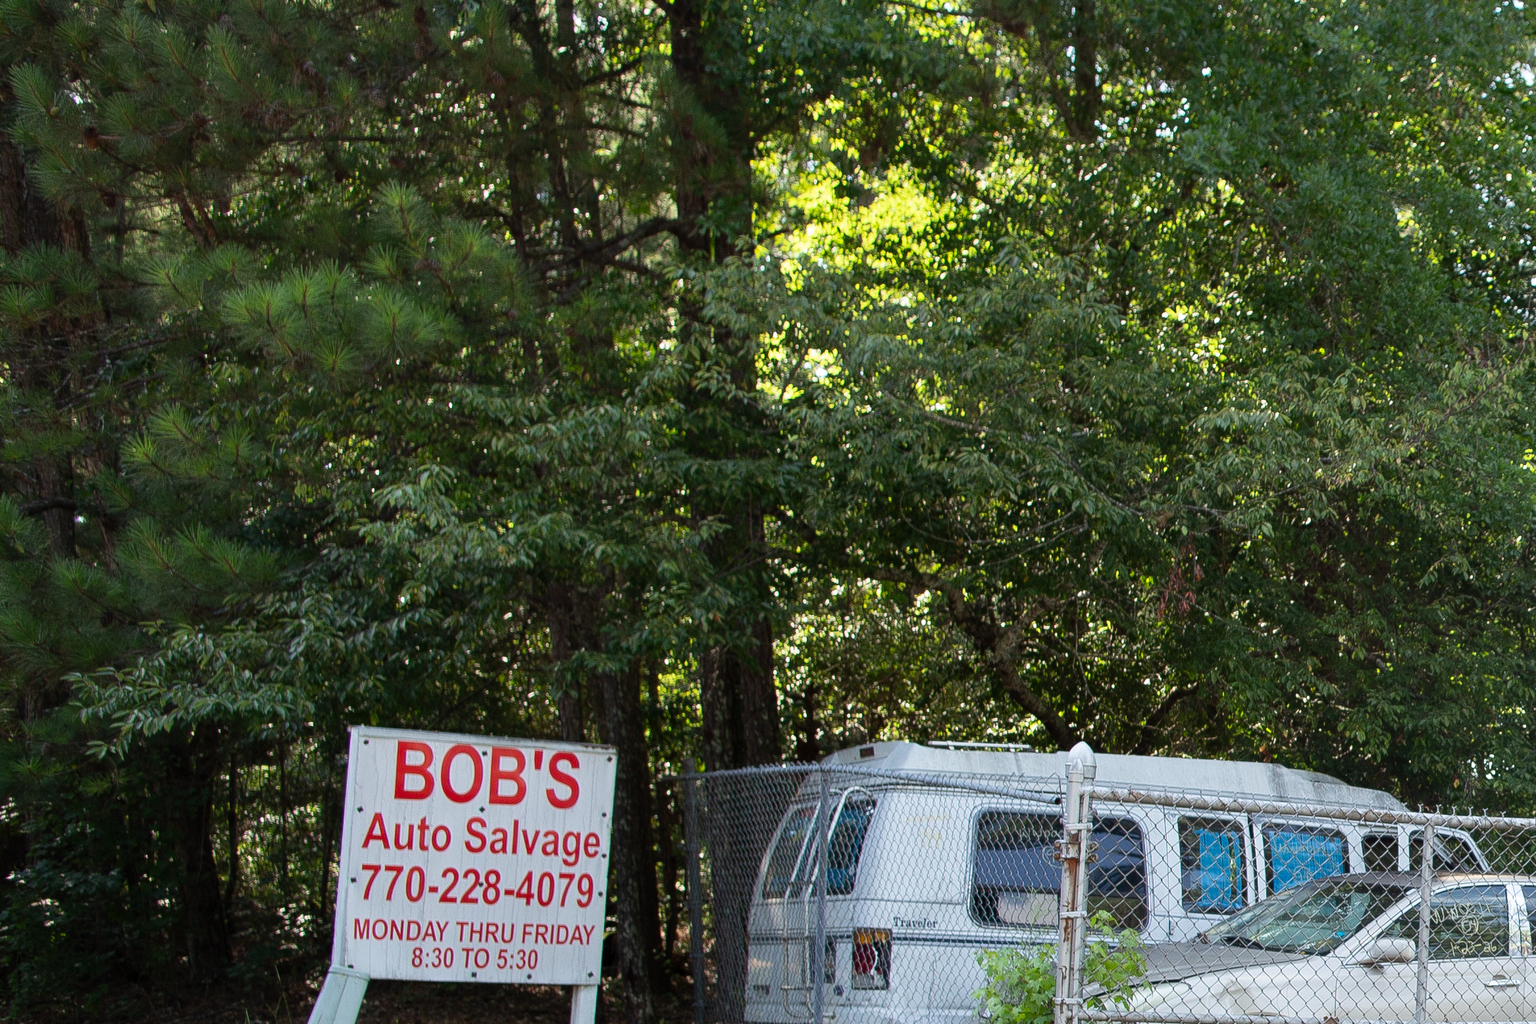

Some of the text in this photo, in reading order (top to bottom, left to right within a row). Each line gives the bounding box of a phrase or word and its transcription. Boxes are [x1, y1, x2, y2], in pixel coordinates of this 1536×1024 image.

[394, 740, 580, 809] BOB'S
[362, 813, 600, 866] Auto Salvage
[362, 864, 593, 908] 770-228-4079
[354, 918, 594, 944] MONDAY THRU FRIDAY
[893, 917, 937, 928] Traveler
[412, 947, 538, 969] 8:30 TO 5:30
